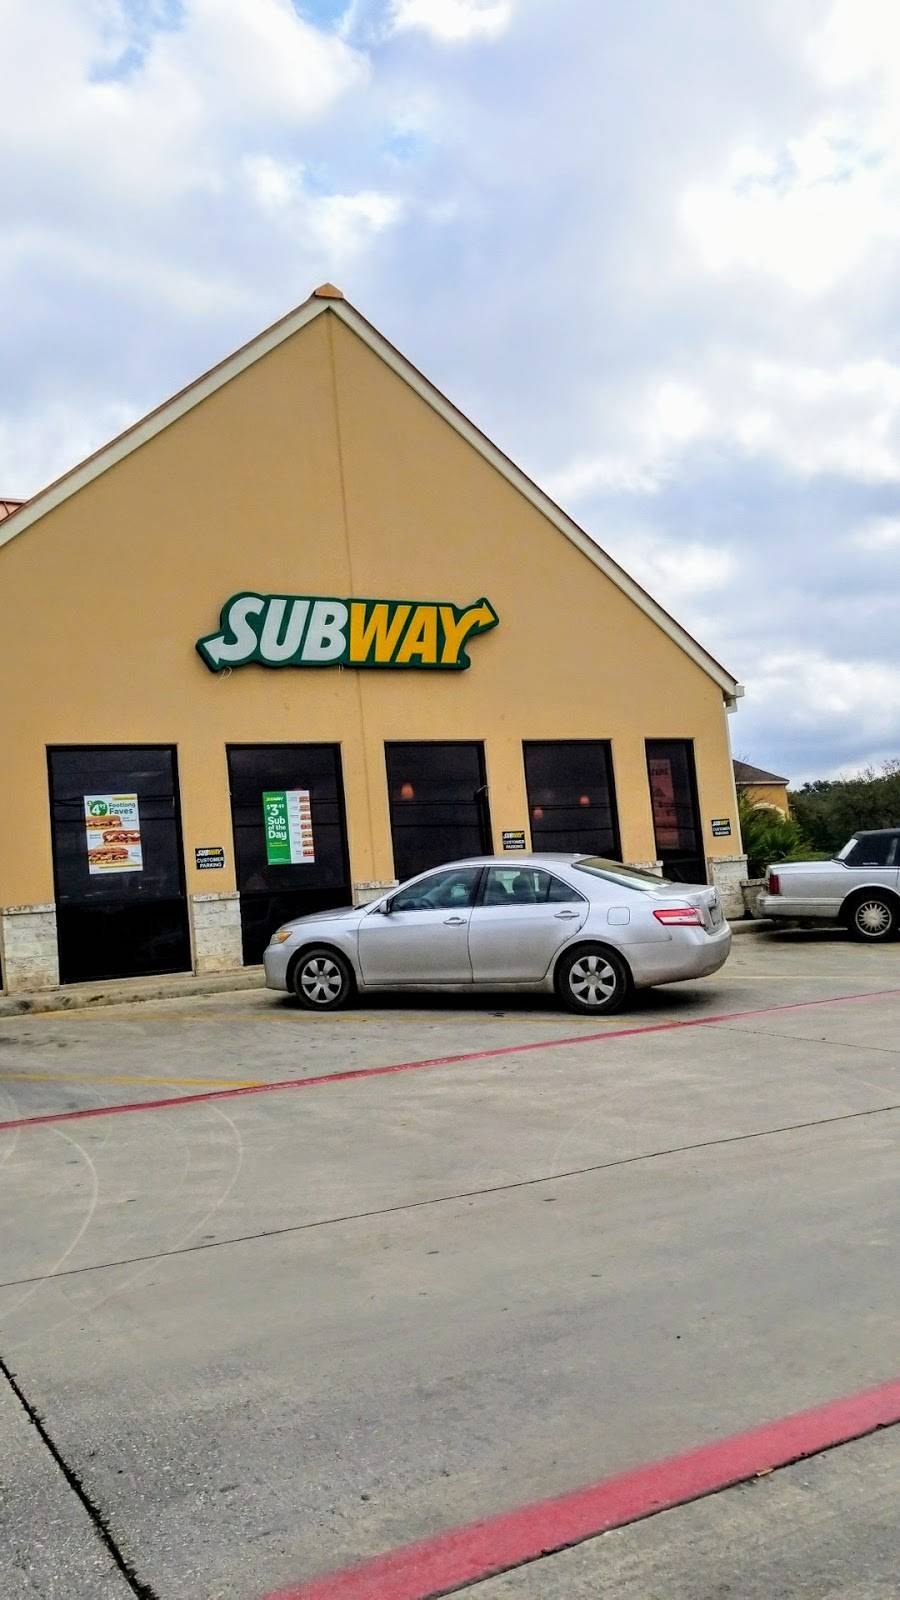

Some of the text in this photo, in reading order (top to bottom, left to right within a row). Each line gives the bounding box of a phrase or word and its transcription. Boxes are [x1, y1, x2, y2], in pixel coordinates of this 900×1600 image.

[203, 596, 496, 664] SUBWAY
[268, 816, 286, 825] Sub
[268, 831, 288, 840] Day
